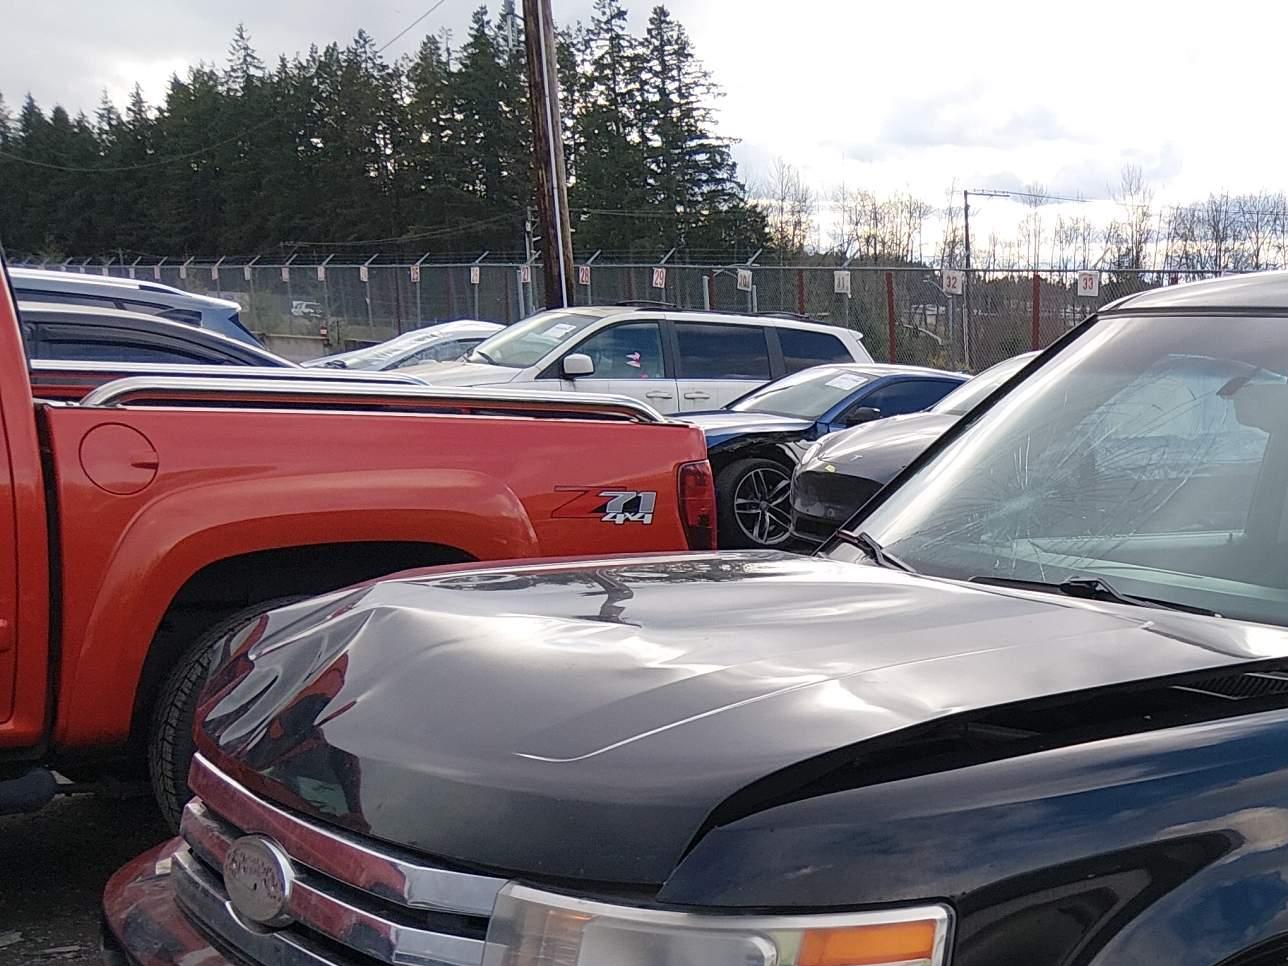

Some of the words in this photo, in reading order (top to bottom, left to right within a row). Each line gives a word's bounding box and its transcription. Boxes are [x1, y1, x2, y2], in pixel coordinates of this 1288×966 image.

[654, 269, 665, 286] 29
[946, 276, 957, 289] 32
[1082, 277, 1094, 290] 33
[551, 485, 657, 518] Z71
